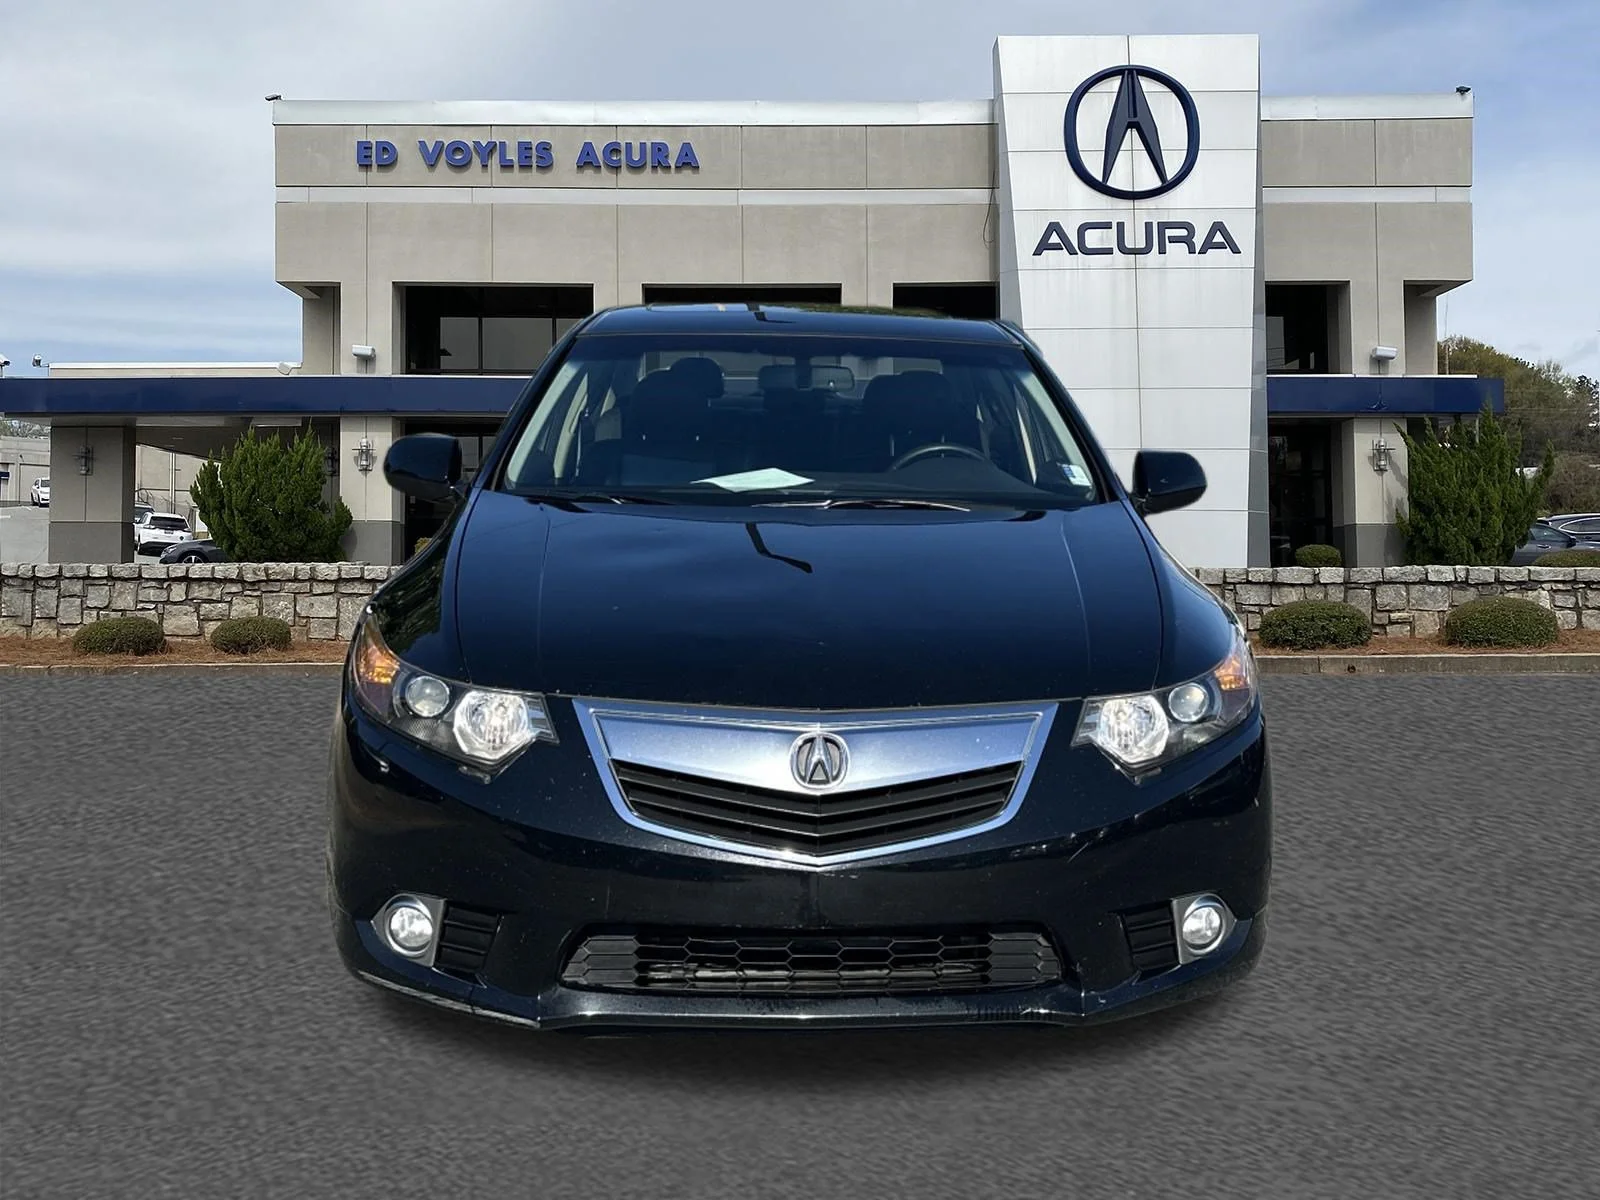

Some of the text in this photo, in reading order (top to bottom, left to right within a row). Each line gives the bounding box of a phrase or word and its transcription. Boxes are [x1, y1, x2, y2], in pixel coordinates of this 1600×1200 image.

[356, 139, 700, 169] ED VOYLES ACURA
[1032, 221, 1242, 256] ACURA
